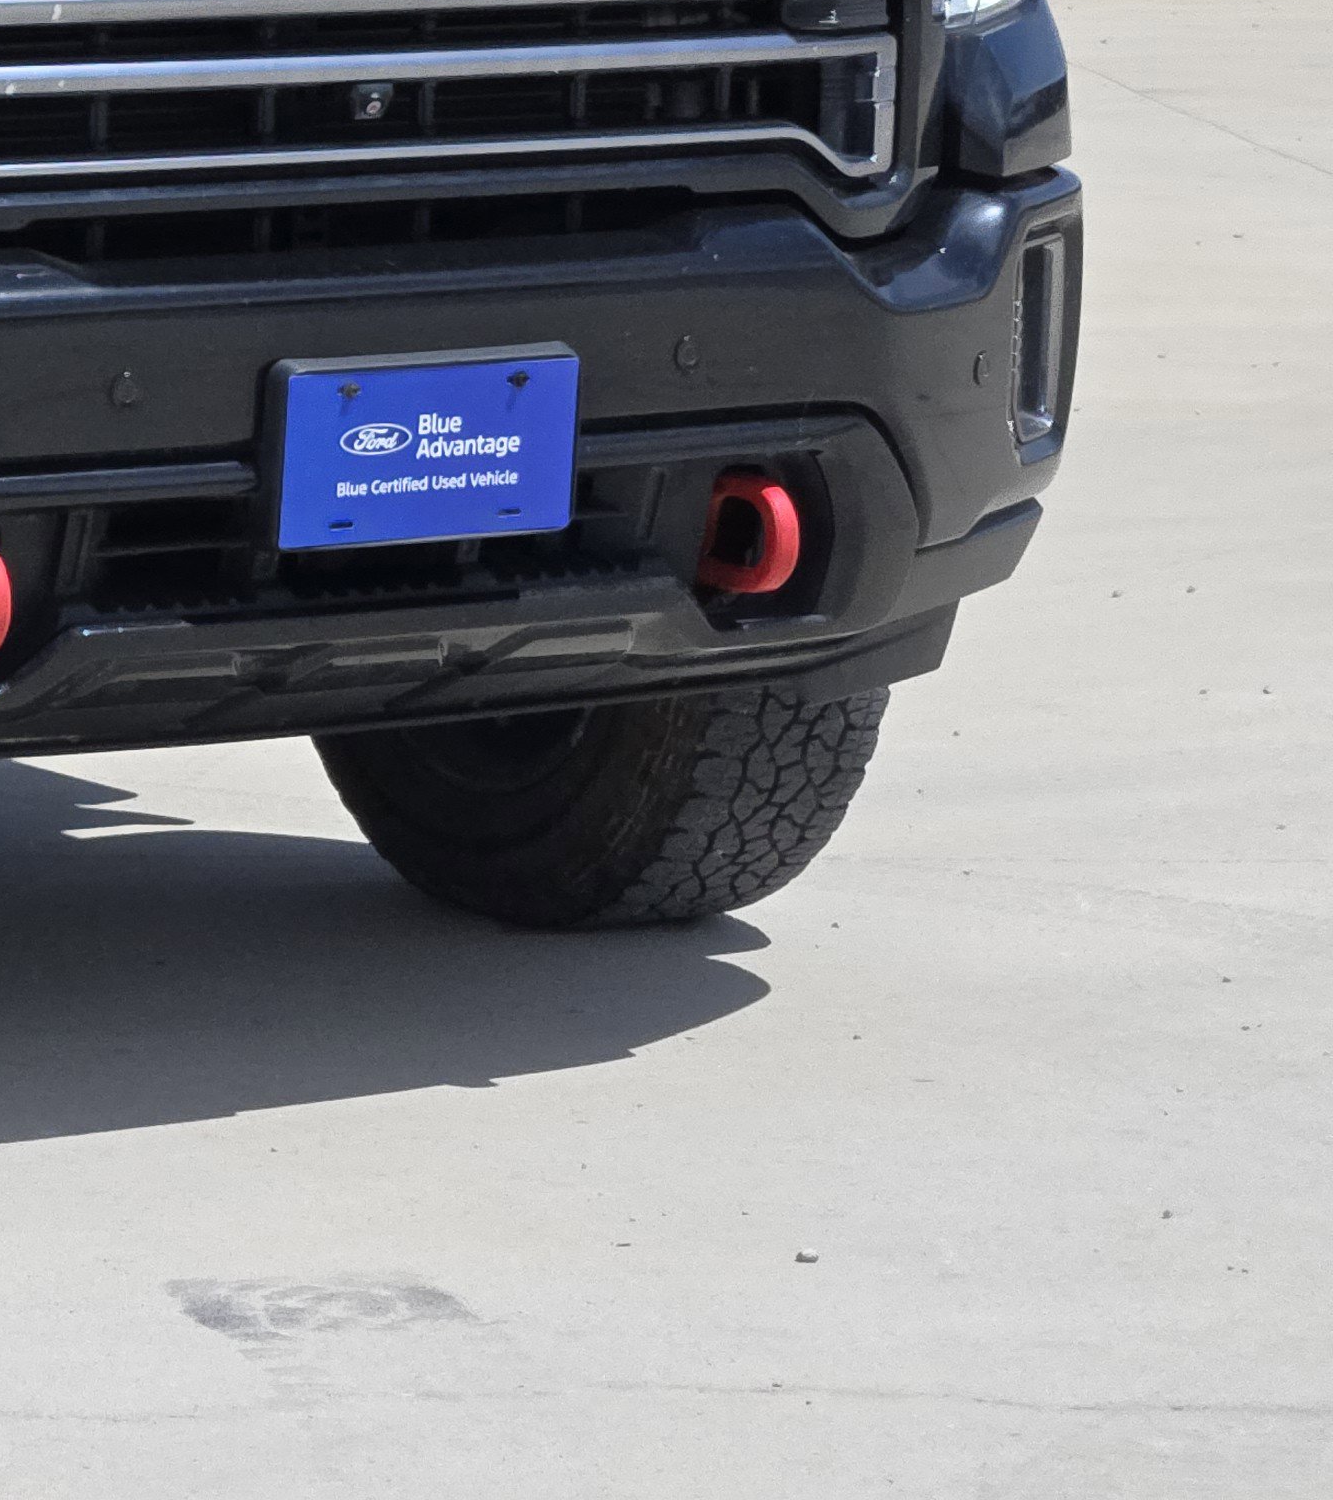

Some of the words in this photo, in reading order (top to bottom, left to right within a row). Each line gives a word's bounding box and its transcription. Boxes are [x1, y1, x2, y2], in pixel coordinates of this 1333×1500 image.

[418, 413, 463, 435] Blue
[353, 428, 400, 451] Ford
[415, 434, 521, 460] Advantage
[336, 481, 368, 498] Blue
[371, 476, 429, 495] Certified
[432, 473, 467, 490] Used
[470, 469, 519, 488] Vehicle
